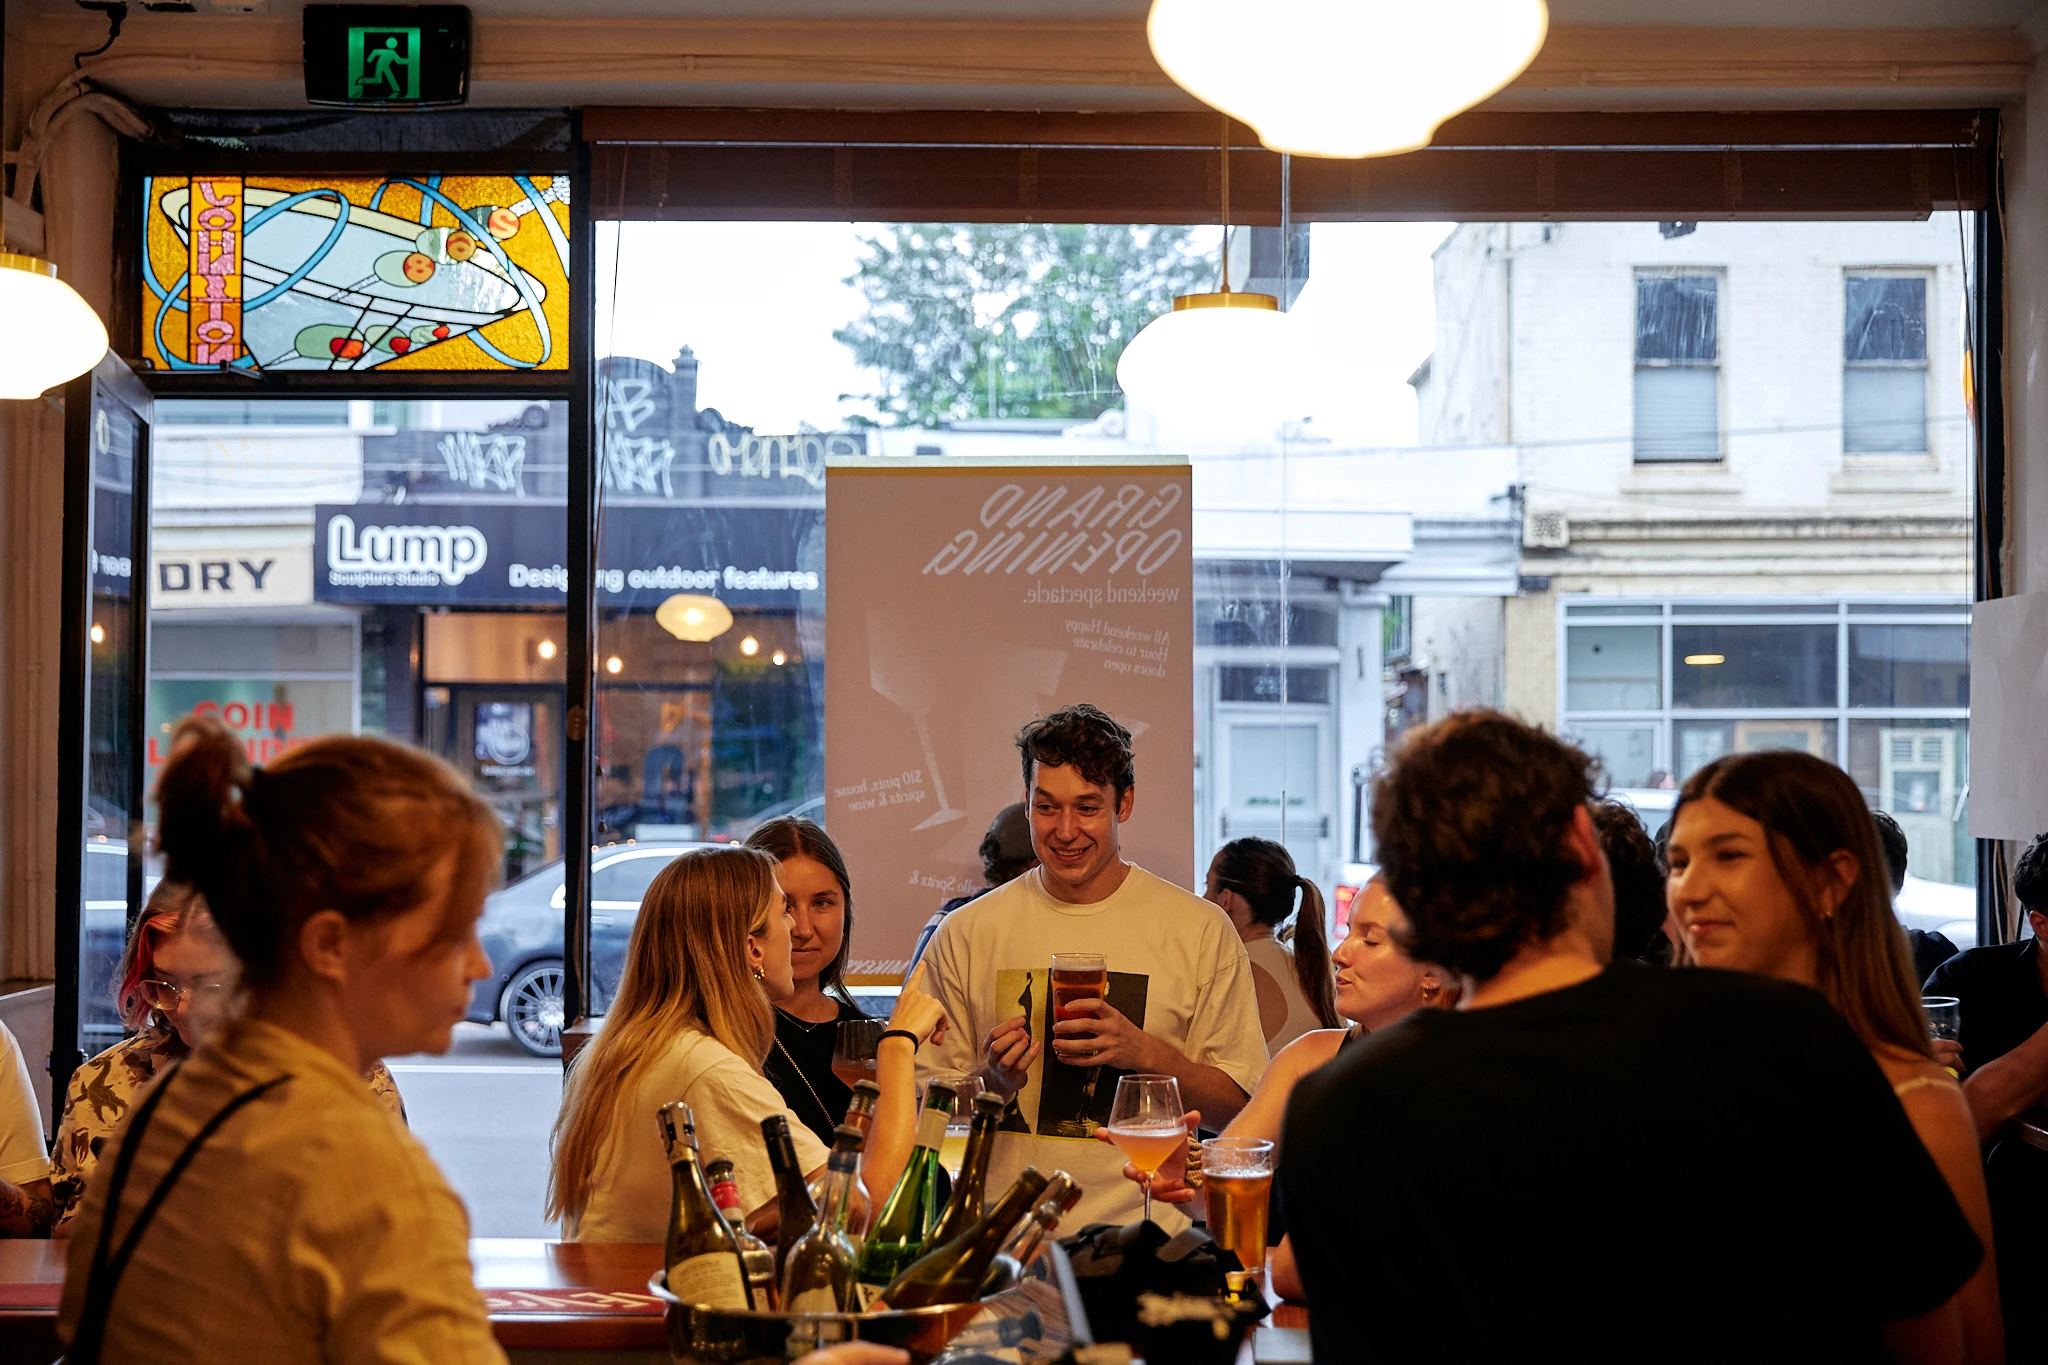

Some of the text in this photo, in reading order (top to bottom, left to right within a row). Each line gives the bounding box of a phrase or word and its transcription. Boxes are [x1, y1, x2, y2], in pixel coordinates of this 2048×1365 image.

[327, 514, 488, 586] Lump
[508, 563, 819, 593] Designg outdoor features
